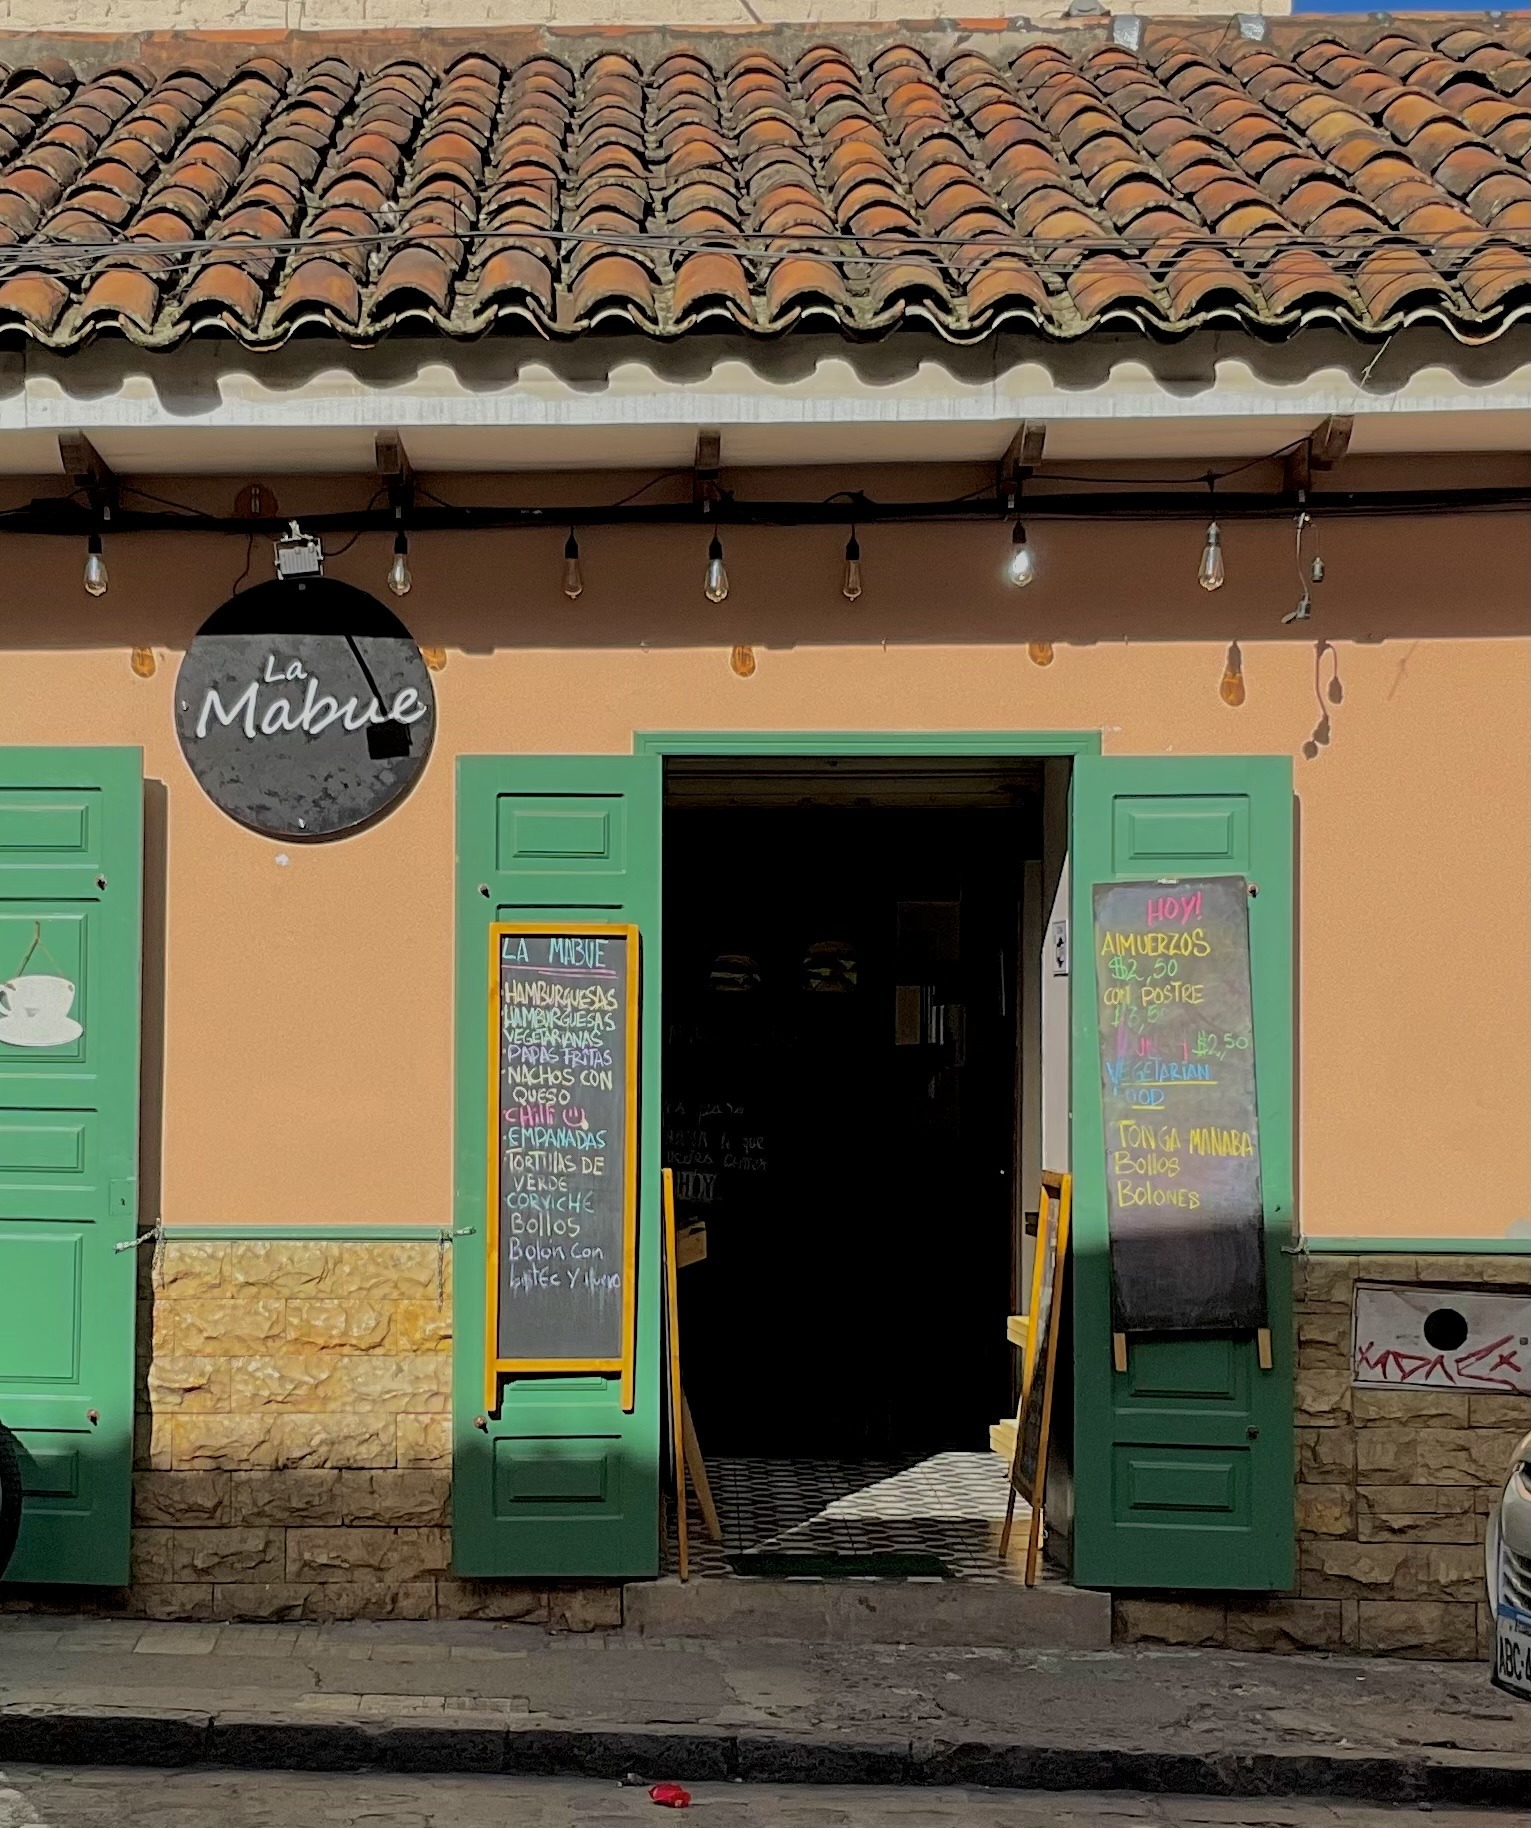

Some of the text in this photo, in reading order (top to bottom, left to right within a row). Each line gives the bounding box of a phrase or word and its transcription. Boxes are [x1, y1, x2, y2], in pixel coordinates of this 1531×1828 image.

[264, 654, 308, 682] La
[196, 677, 427, 738] Mabue
[1147, 891, 1203, 927] HOY!
[502, 937, 609, 968] LA MABUE
[504, 980, 618, 1011] HAMBURGUESAS
[503, 1004, 616, 1031] HAMBURGUESAS
[507, 1045, 559, 1064] PAPAS
[507, 1065, 613, 1091] NACHOS CON
[512, 1085, 571, 1105] QUESO
[508, 1127, 608, 1150] EMPANADAS
[581, 1156, 605, 1175] DE
